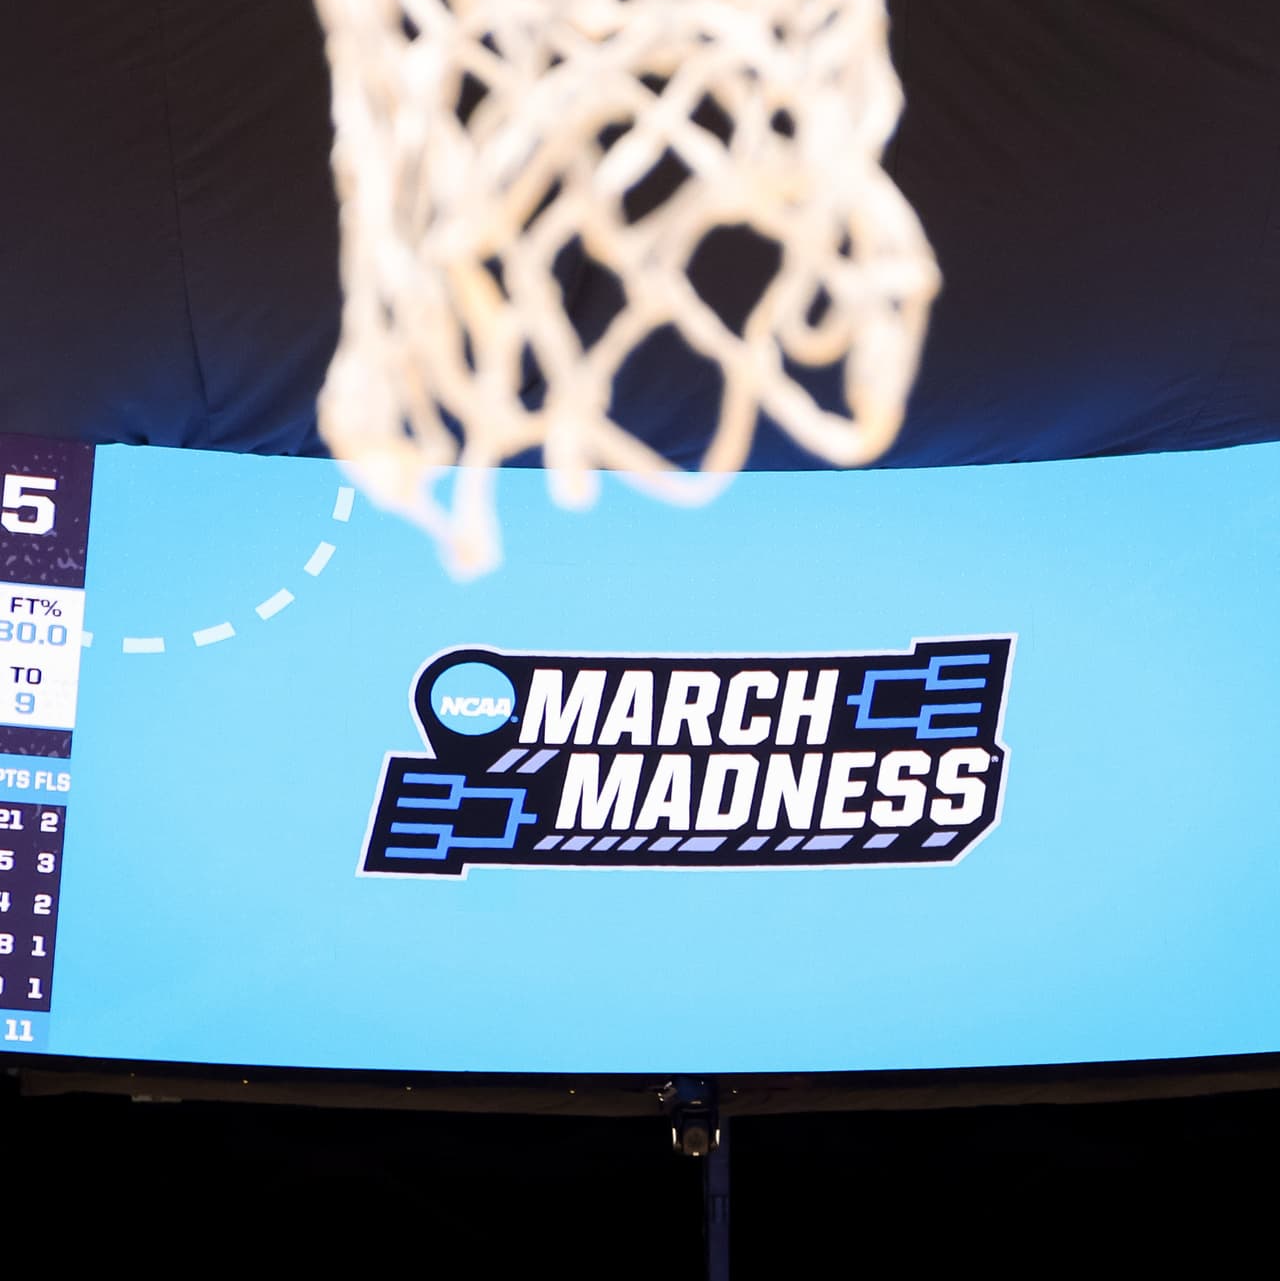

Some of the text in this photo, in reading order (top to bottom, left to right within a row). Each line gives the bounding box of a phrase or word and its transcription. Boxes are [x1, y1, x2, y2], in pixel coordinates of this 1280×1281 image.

[10, 596, 63, 618] FT%
[10, 666, 44, 686] TO
[14, 692, 36, 715] 9
[439, 696, 512, 718] NCAA
[519, 669, 840, 746] MARCH
[35, 771, 72, 792] FLS
[555, 747, 991, 831] MADNESS
[40, 811, 59, 833] 2
[36, 853, 56, 874] 3
[33, 893, 52, 916] 2
[30, 935, 47, 957] 1
[27, 977, 44, 999] 1
[5, 1020, 34, 1042] 11
